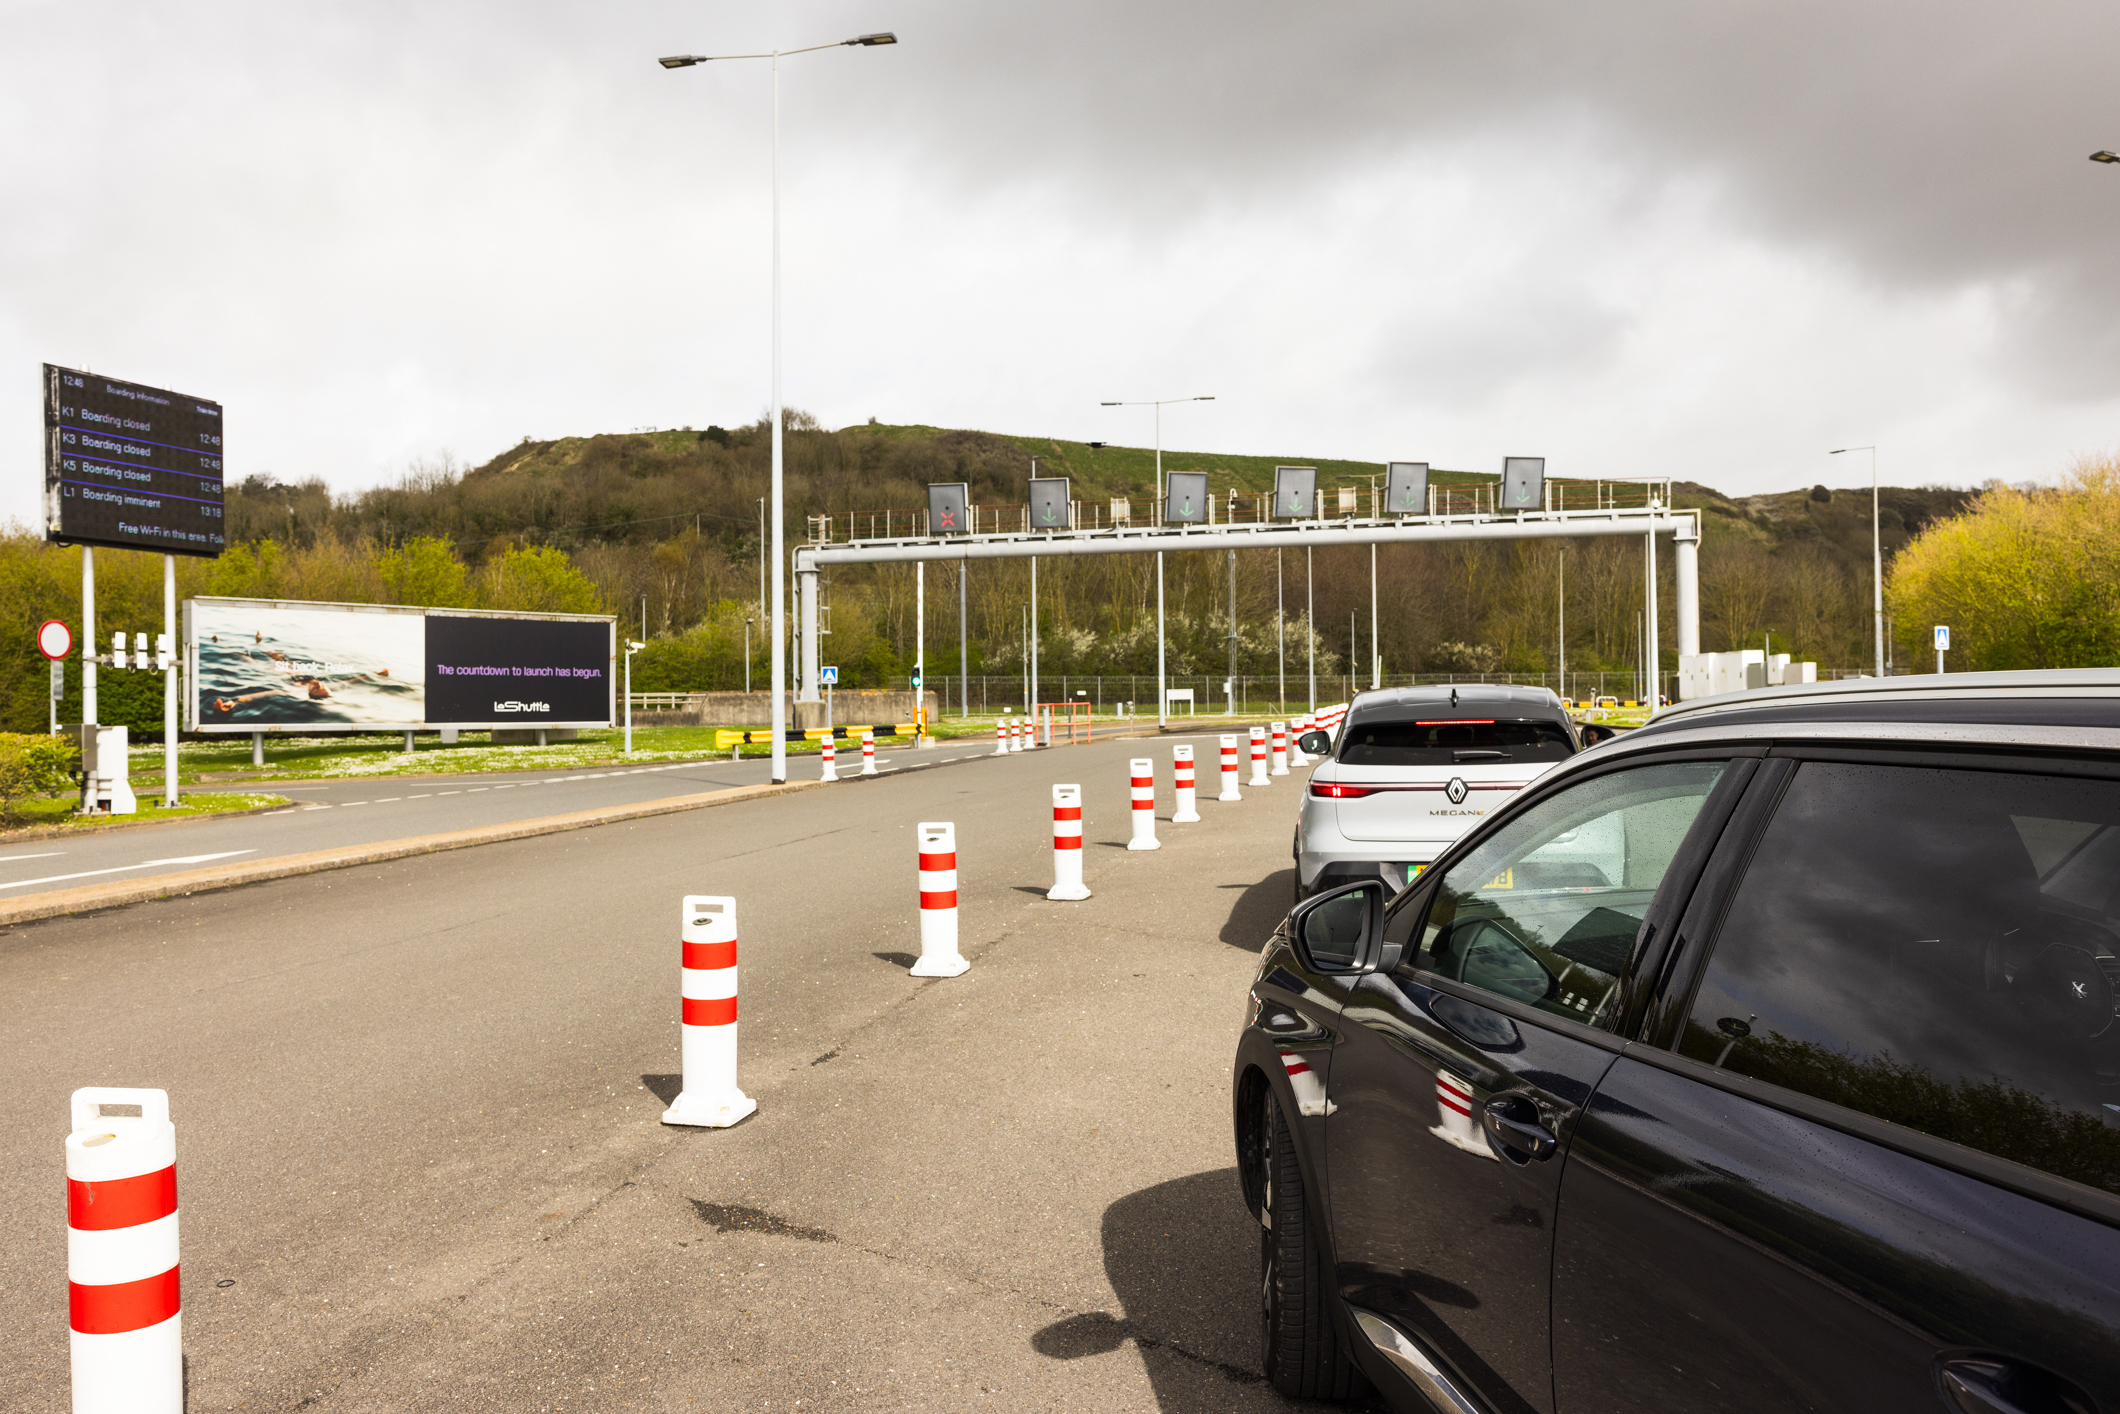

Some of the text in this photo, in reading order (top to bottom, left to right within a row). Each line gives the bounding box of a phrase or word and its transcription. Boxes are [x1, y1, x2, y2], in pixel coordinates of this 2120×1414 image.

[106, 384, 170, 405] Boarding Information
[62, 406, 221, 446] K1 Boarding closed 12:48
[62, 432, 221, 470] K3 Boarding closed 12:48
[63, 459, 221, 494] K5 Boarding closed 12:48
[63, 486, 75, 497] L1
[82, 488, 122, 505] Boarding
[124, 494, 161, 508] imminent
[118, 522, 139, 534] Free
[139, 525, 162, 536] Wi-Fi
[162, 527, 171, 537] in
[172, 529, 186, 539] this
[275, 661, 290, 673] Sit
[437, 664, 602, 679] The countdown to launch has begun.
